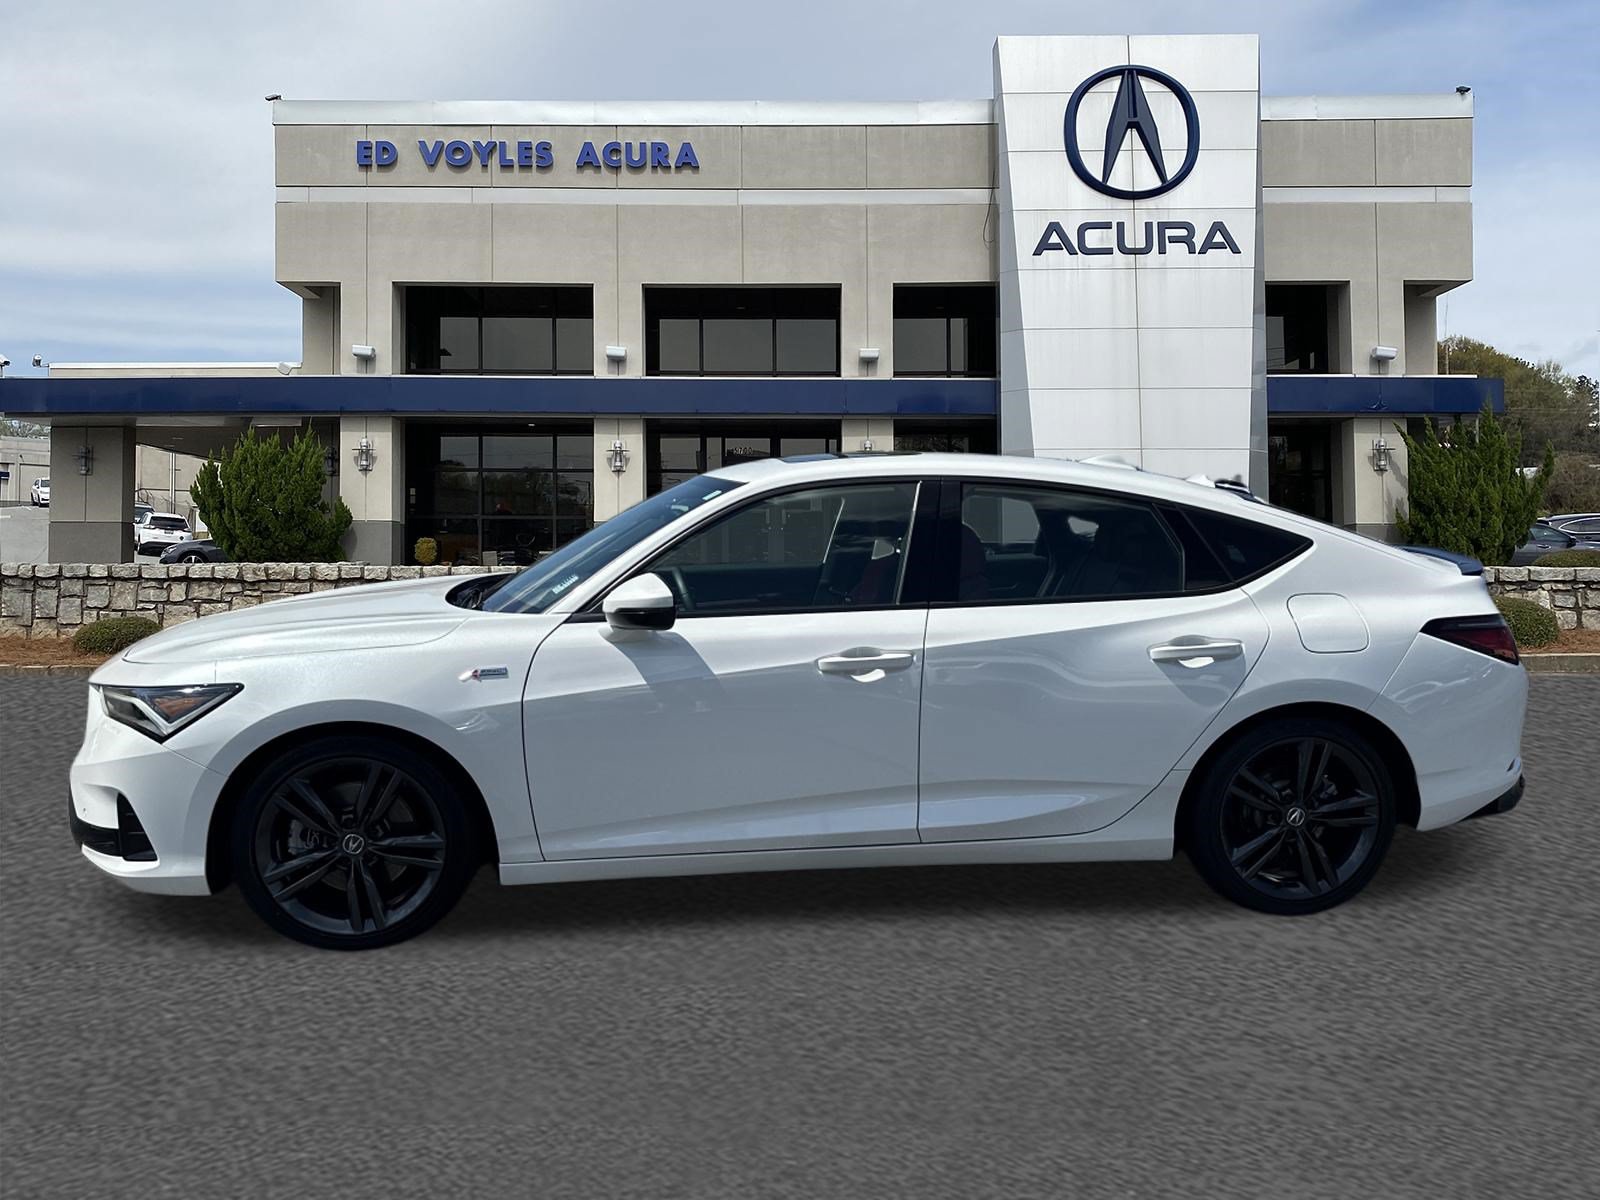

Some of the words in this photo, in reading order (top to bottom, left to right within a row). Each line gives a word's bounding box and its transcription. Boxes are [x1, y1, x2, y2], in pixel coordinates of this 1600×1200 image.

[355, 140, 397, 168] ED
[418, 140, 554, 168] VOYLES
[576, 141, 700, 169] ACURA
[1032, 221, 1242, 256] ACURA
